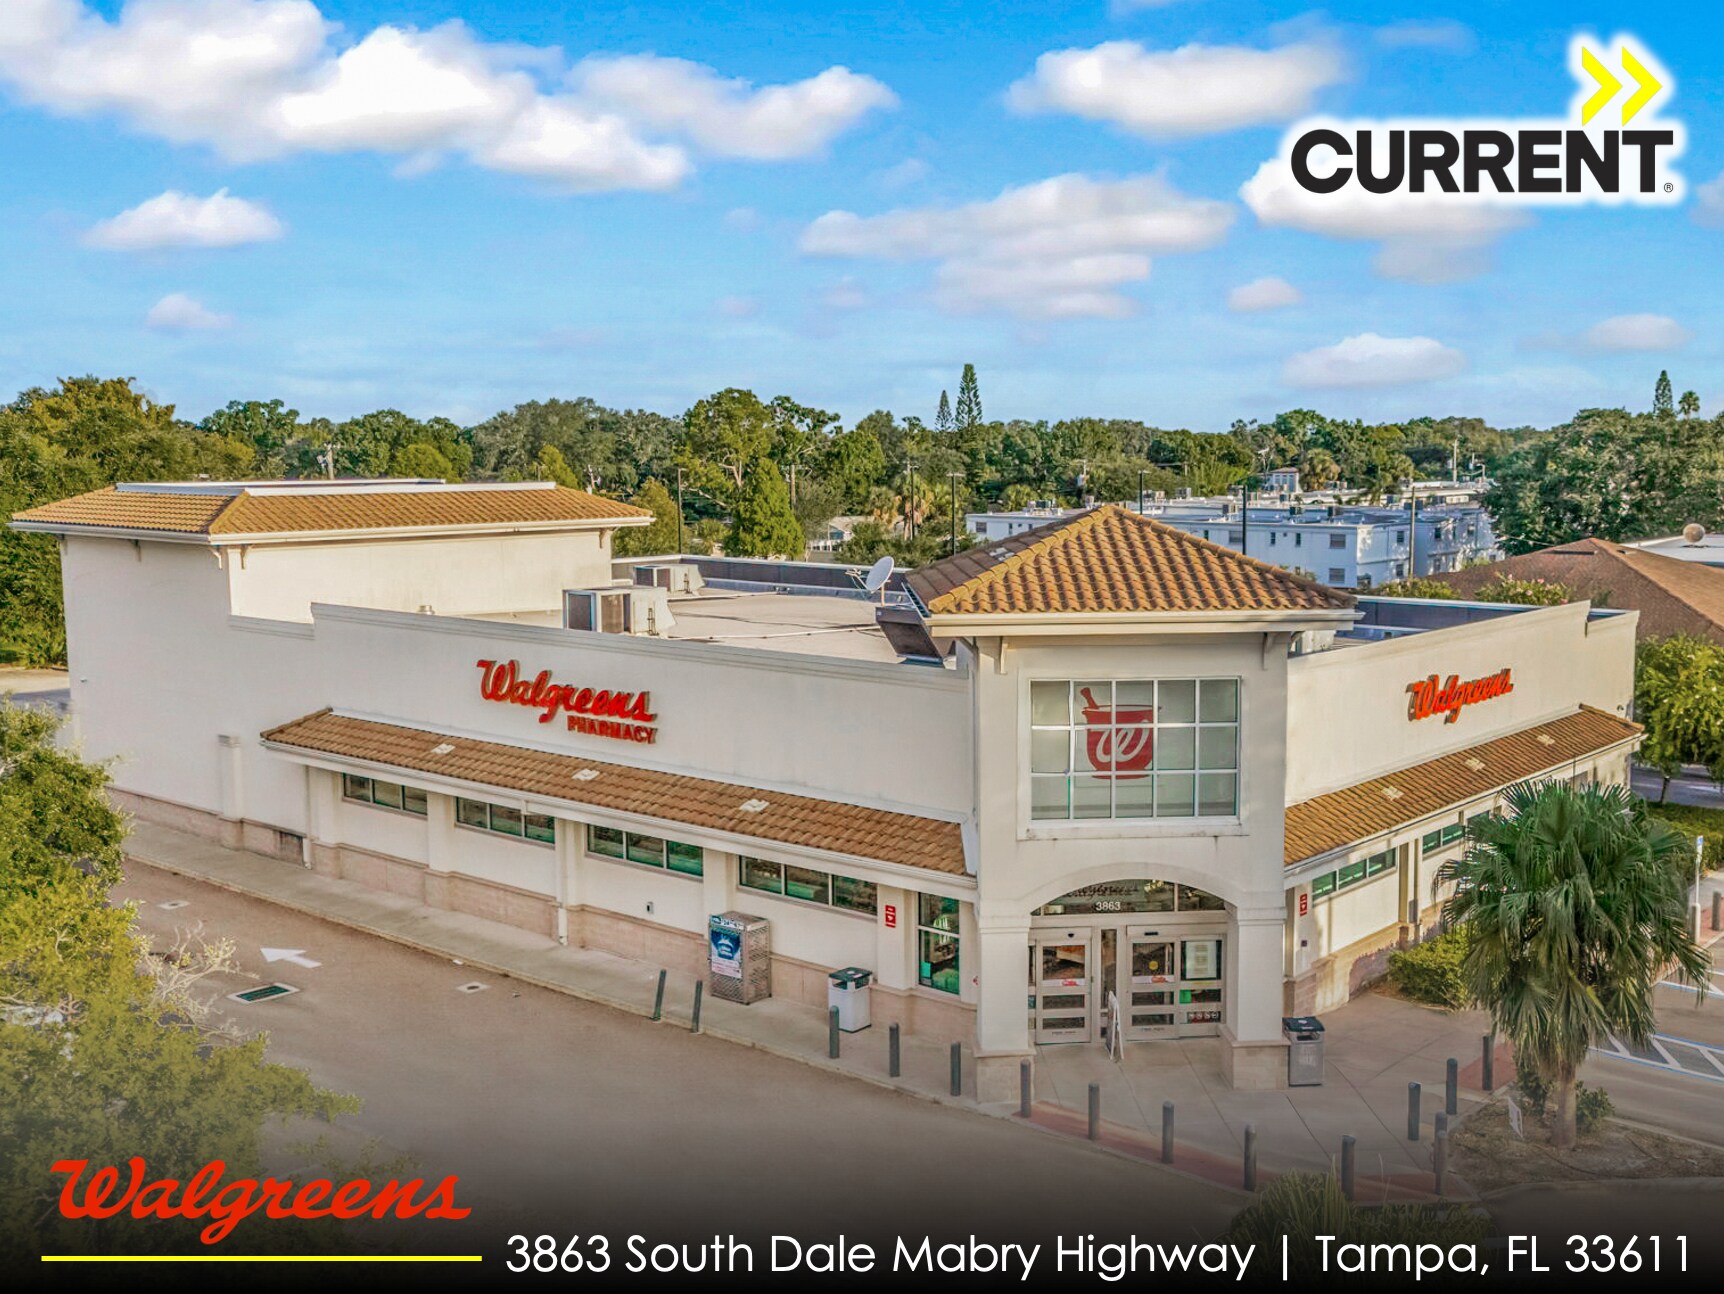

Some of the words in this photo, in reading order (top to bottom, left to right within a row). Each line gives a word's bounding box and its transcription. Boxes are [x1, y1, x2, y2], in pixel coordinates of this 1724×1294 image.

[476, 659, 658, 724] Walgreens
[1405, 668, 1513, 724] Walgreens
[567, 715, 657, 744] PHARMACY
[1095, 901, 1121, 911] 3863
